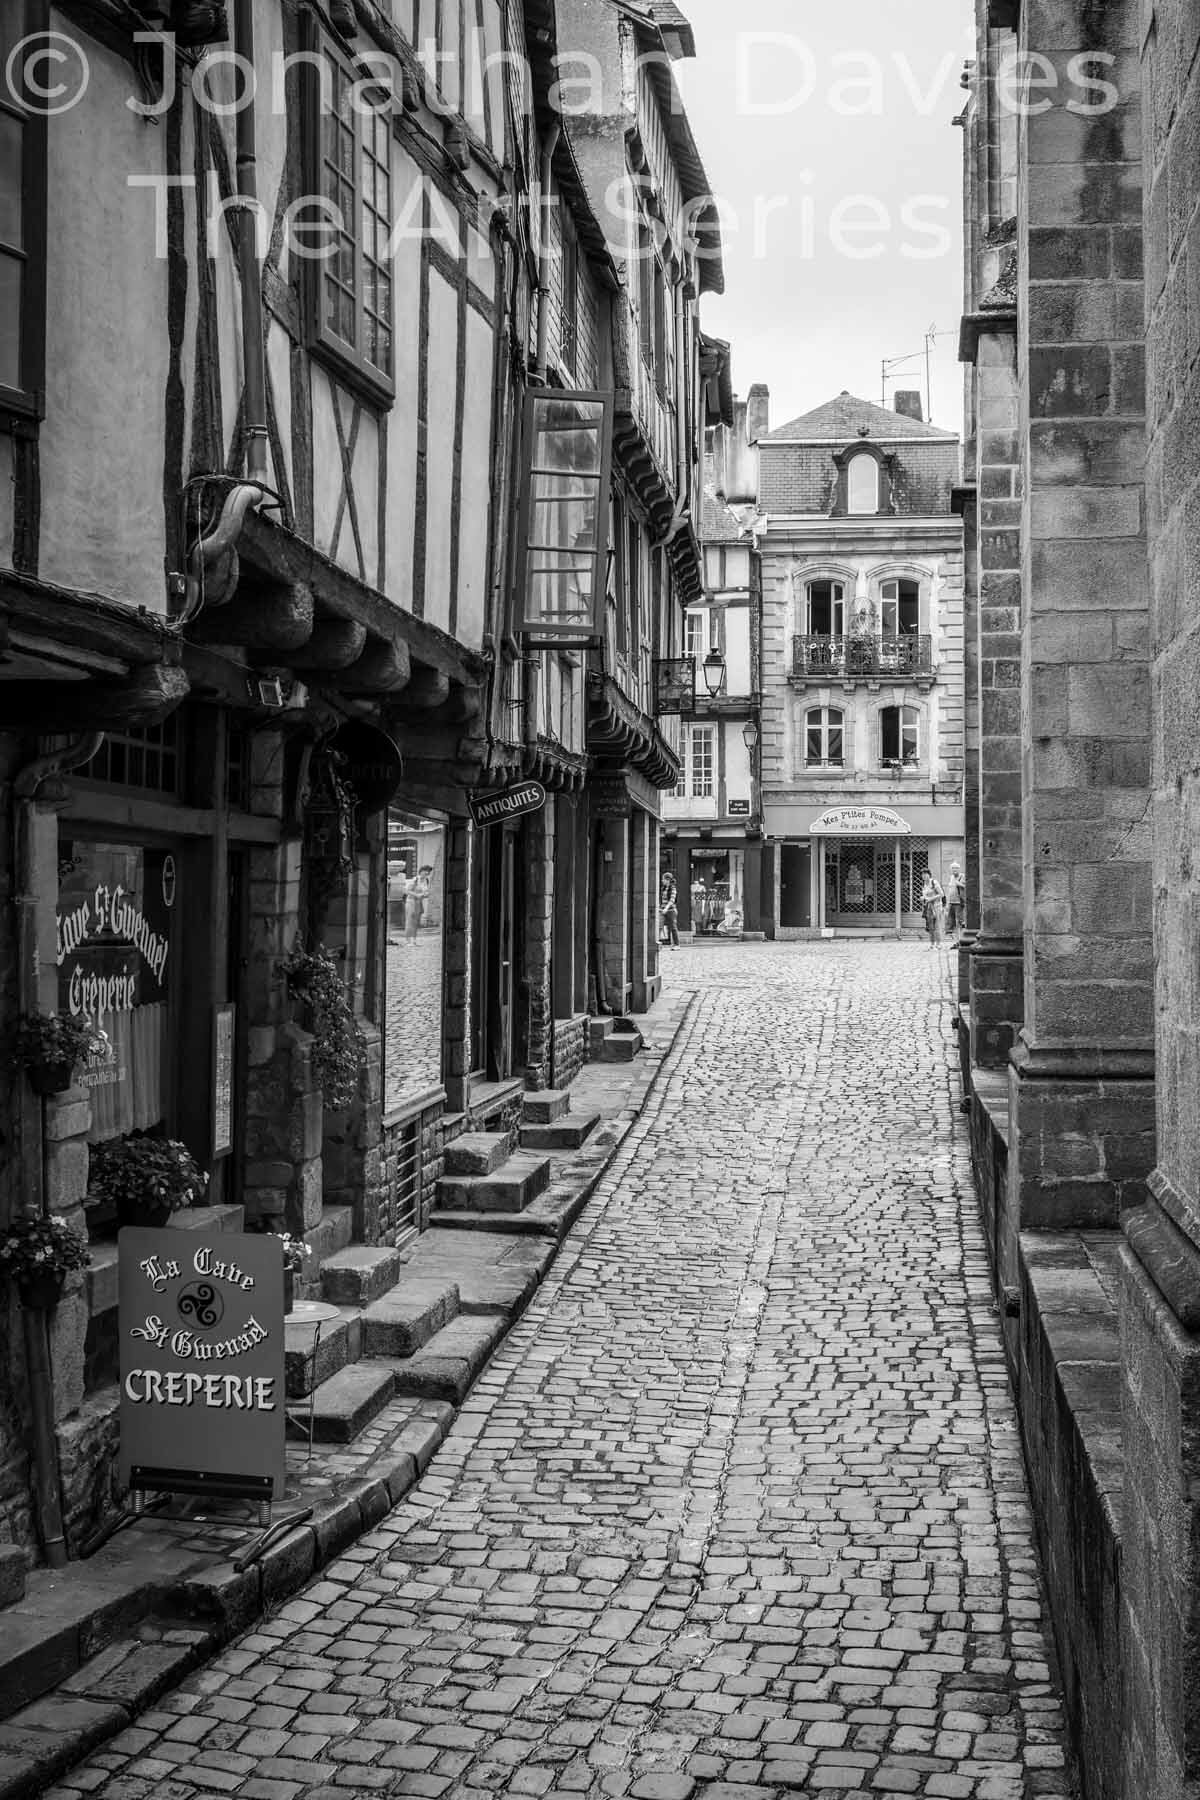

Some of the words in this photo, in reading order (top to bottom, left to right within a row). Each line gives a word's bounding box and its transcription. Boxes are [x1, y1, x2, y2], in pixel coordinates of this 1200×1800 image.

[477, 787, 540, 821] ANTIQUITES
[140, 1255, 181, 1293] La
[193, 1247, 255, 1290] Cave
[130, 1315, 171, 1349] St
[125, 1369, 276, 1411] CREPERIE
